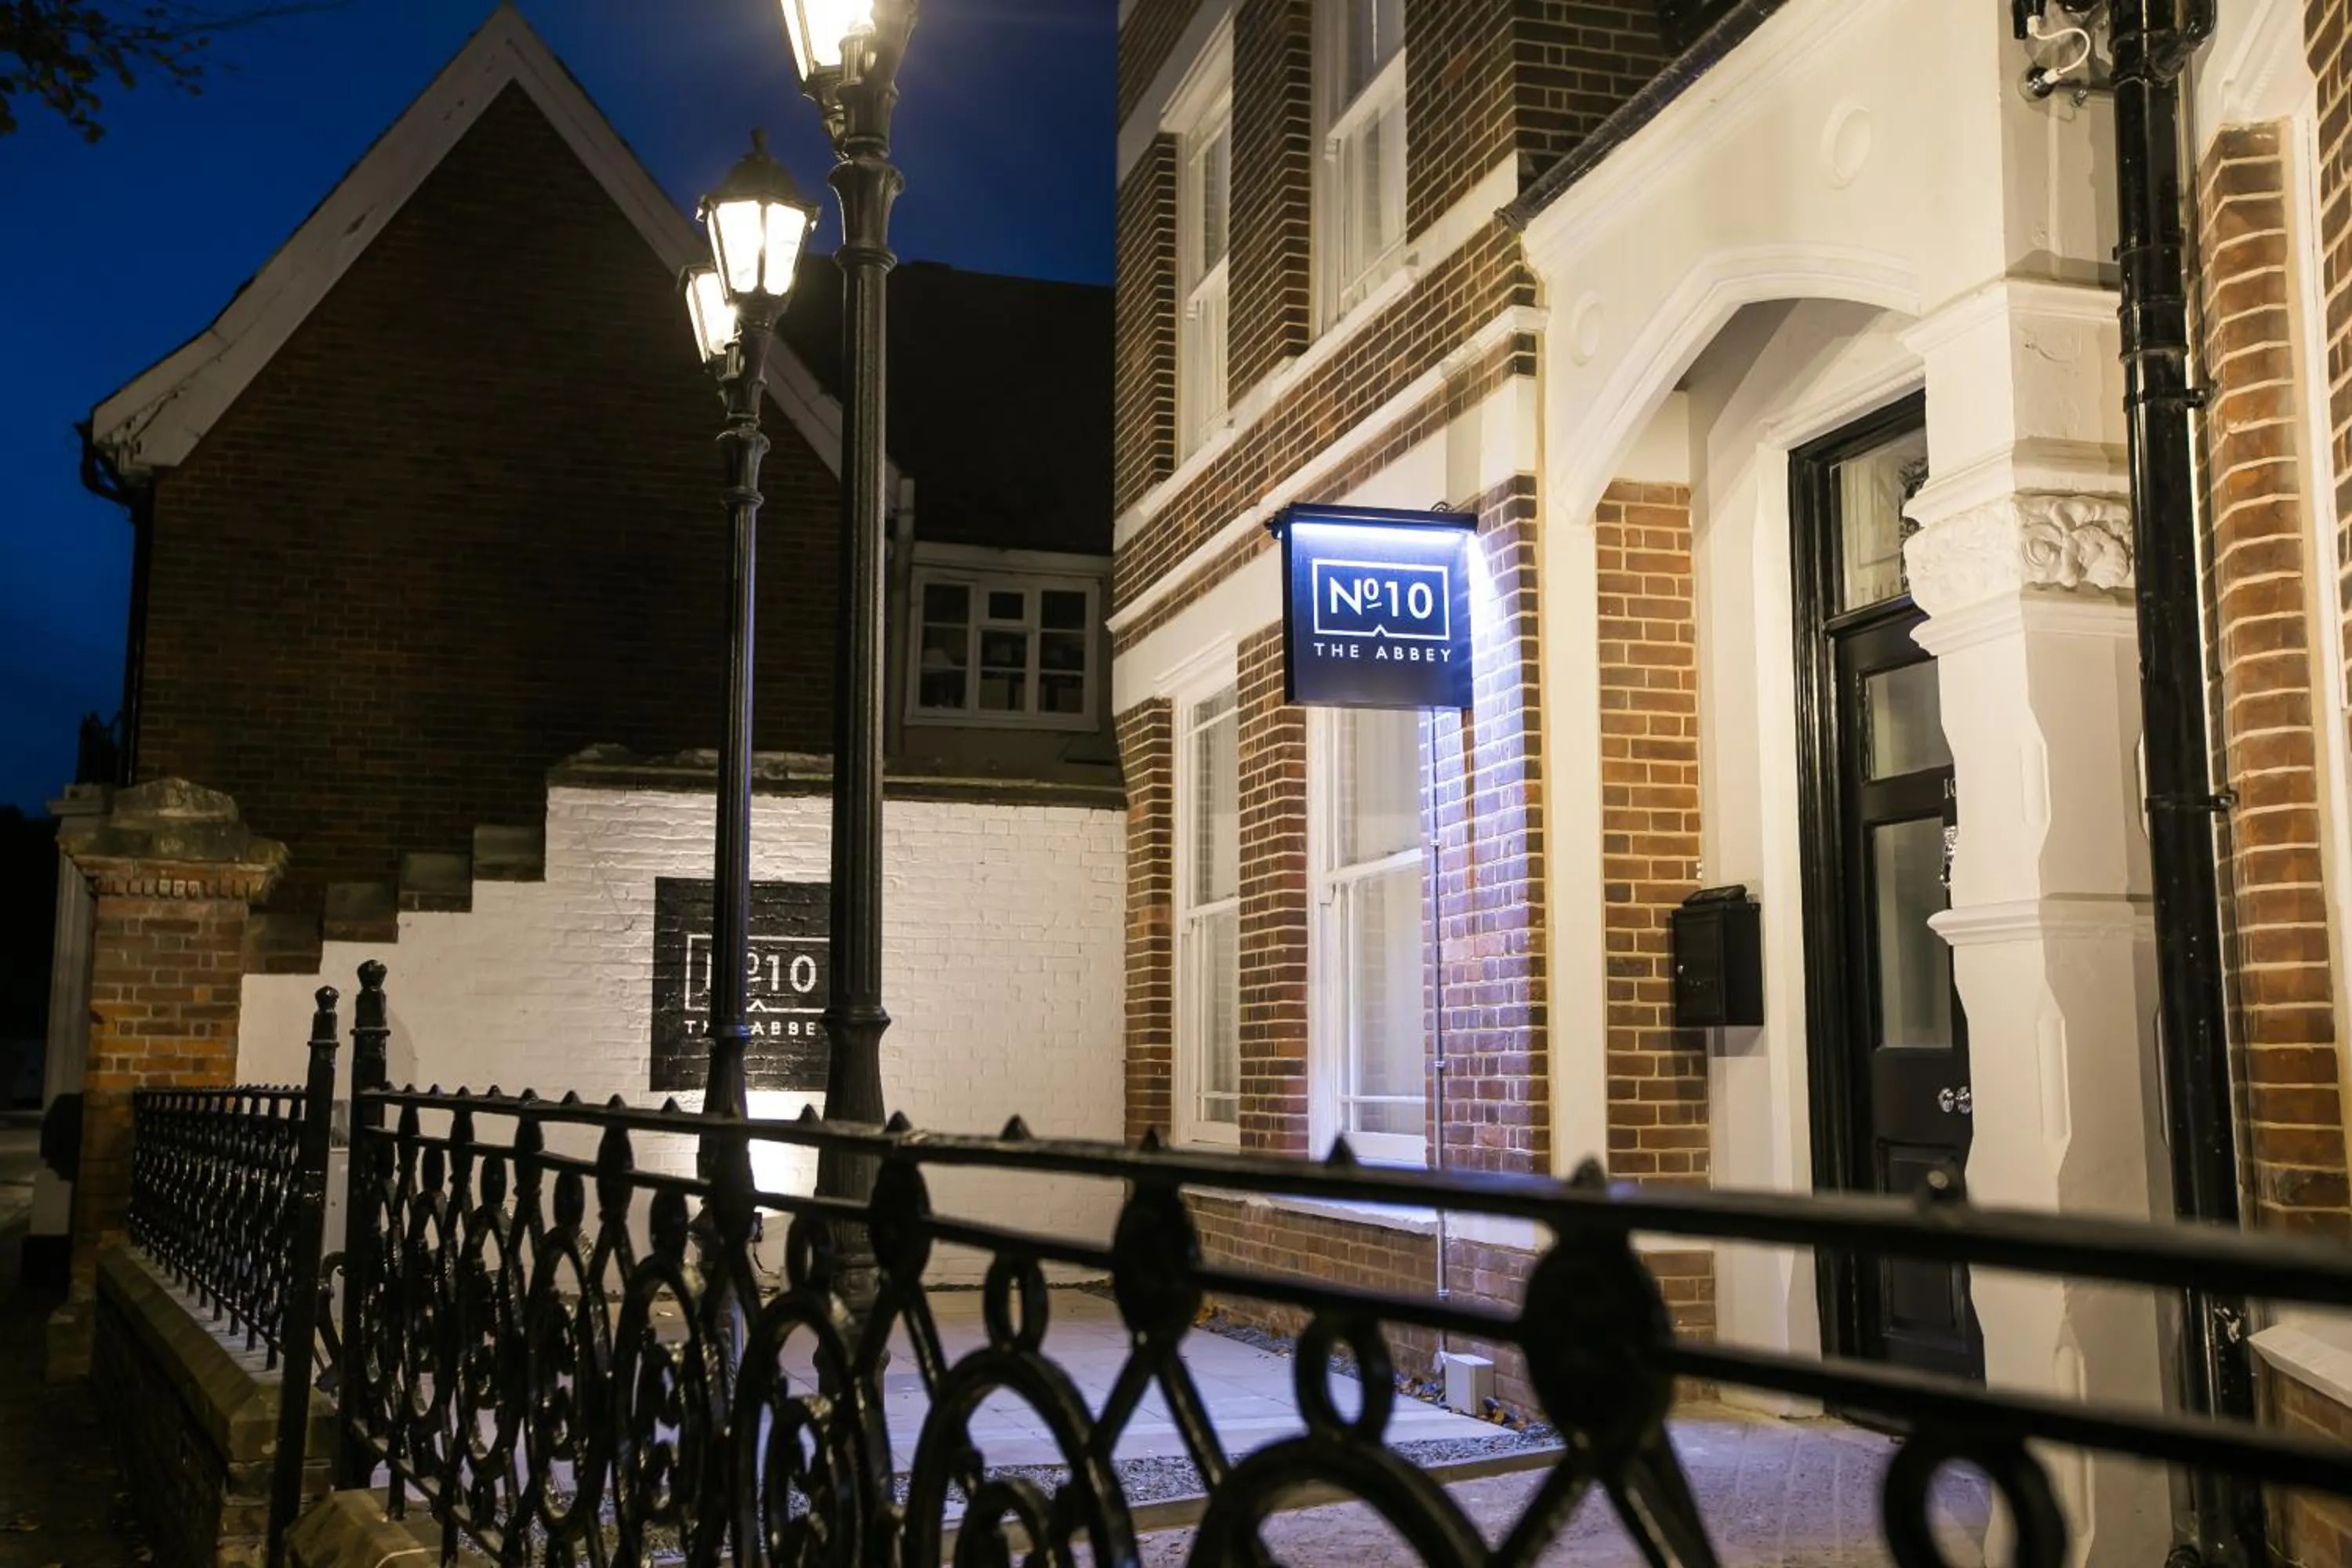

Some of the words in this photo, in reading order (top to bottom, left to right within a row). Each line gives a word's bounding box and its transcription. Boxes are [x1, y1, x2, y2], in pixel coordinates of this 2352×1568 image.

[1313, 643, 1359, 659] THE
[1375, 645, 1452, 663] ABBEY
[750, 1021, 816, 1036] ABBE
